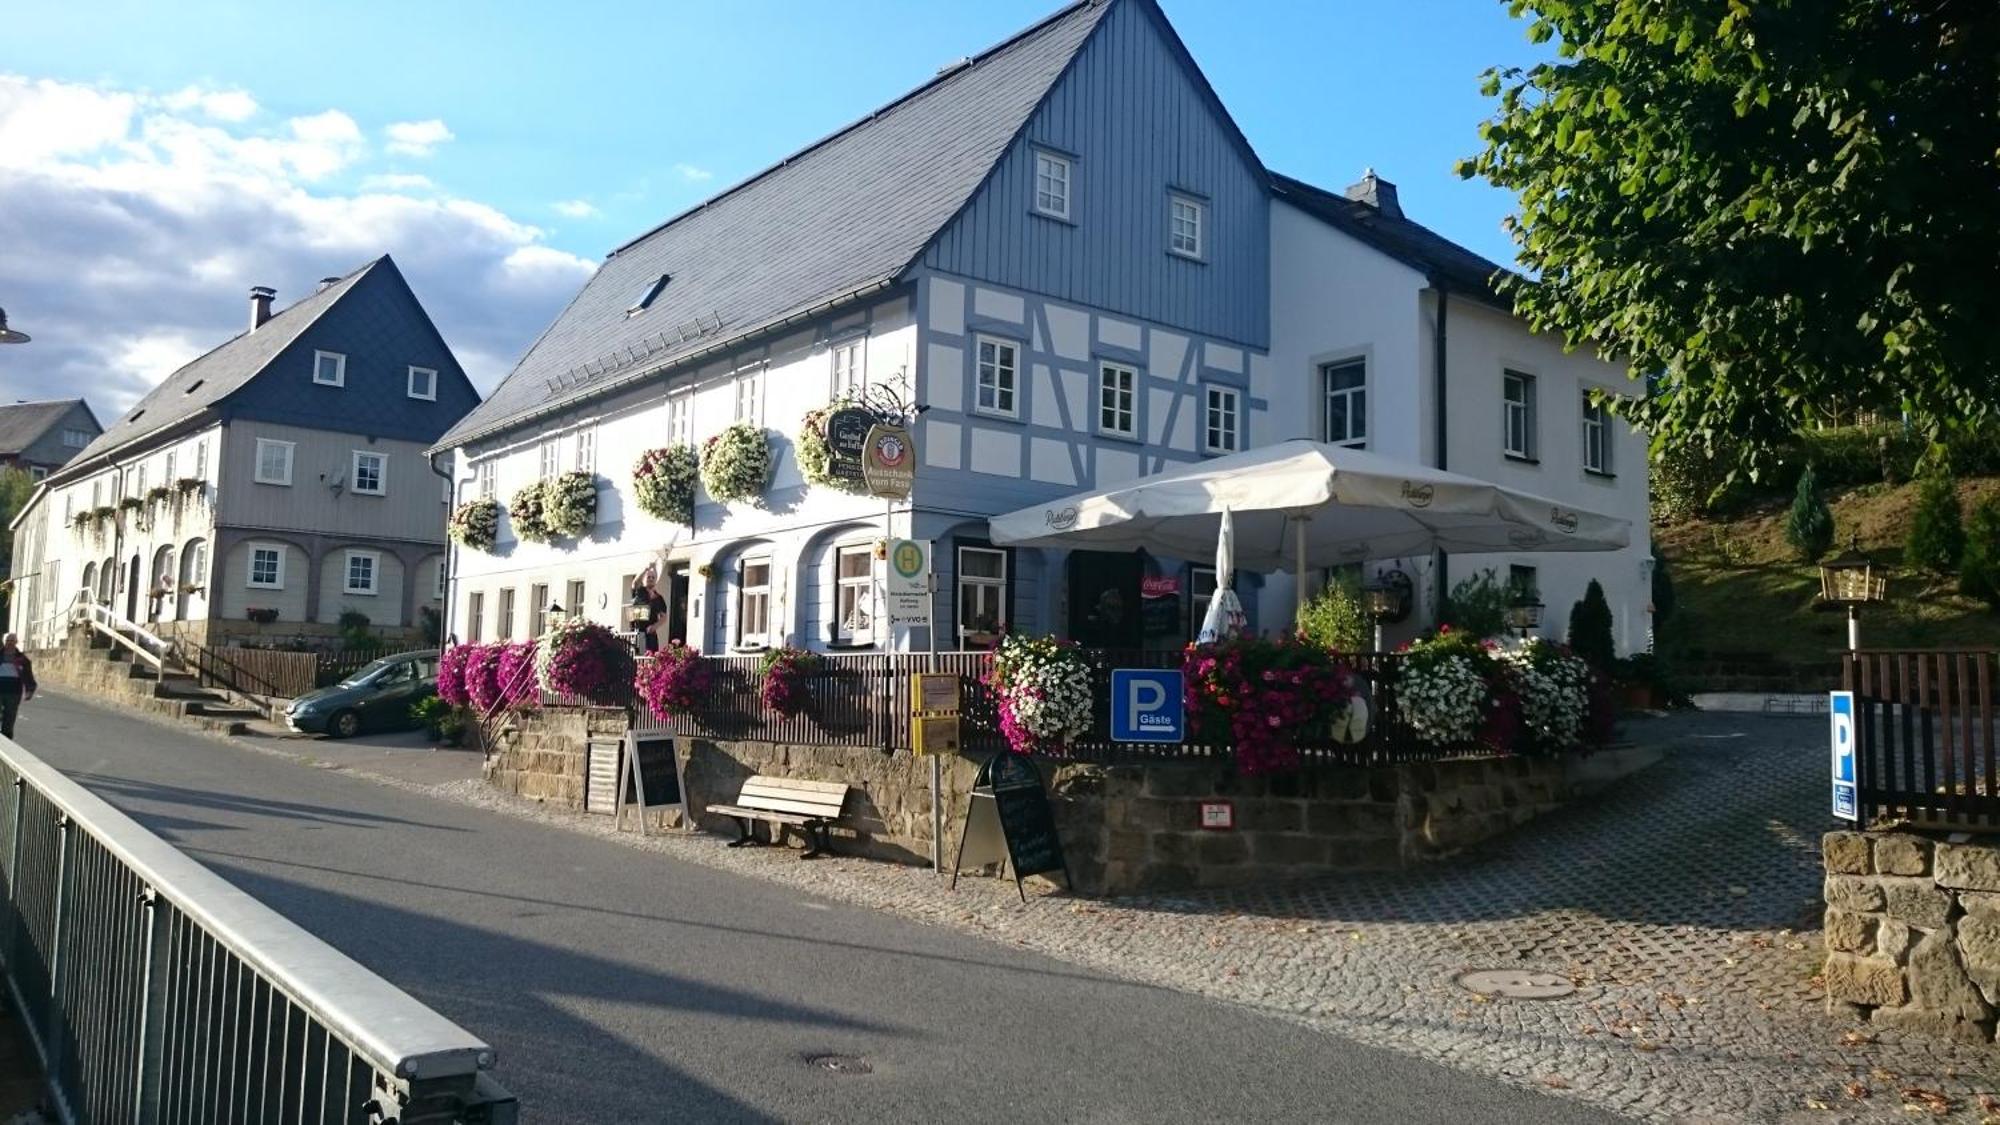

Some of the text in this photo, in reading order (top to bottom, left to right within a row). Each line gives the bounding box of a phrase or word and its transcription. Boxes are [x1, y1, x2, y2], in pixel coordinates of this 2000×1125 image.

[868, 466, 913, 479] Ausschank
[902, 548, 915, 570] H
[1129, 680, 1166, 731] P
[1140, 714, 1171, 724] Gäste
[1834, 712, 1852, 779] P
